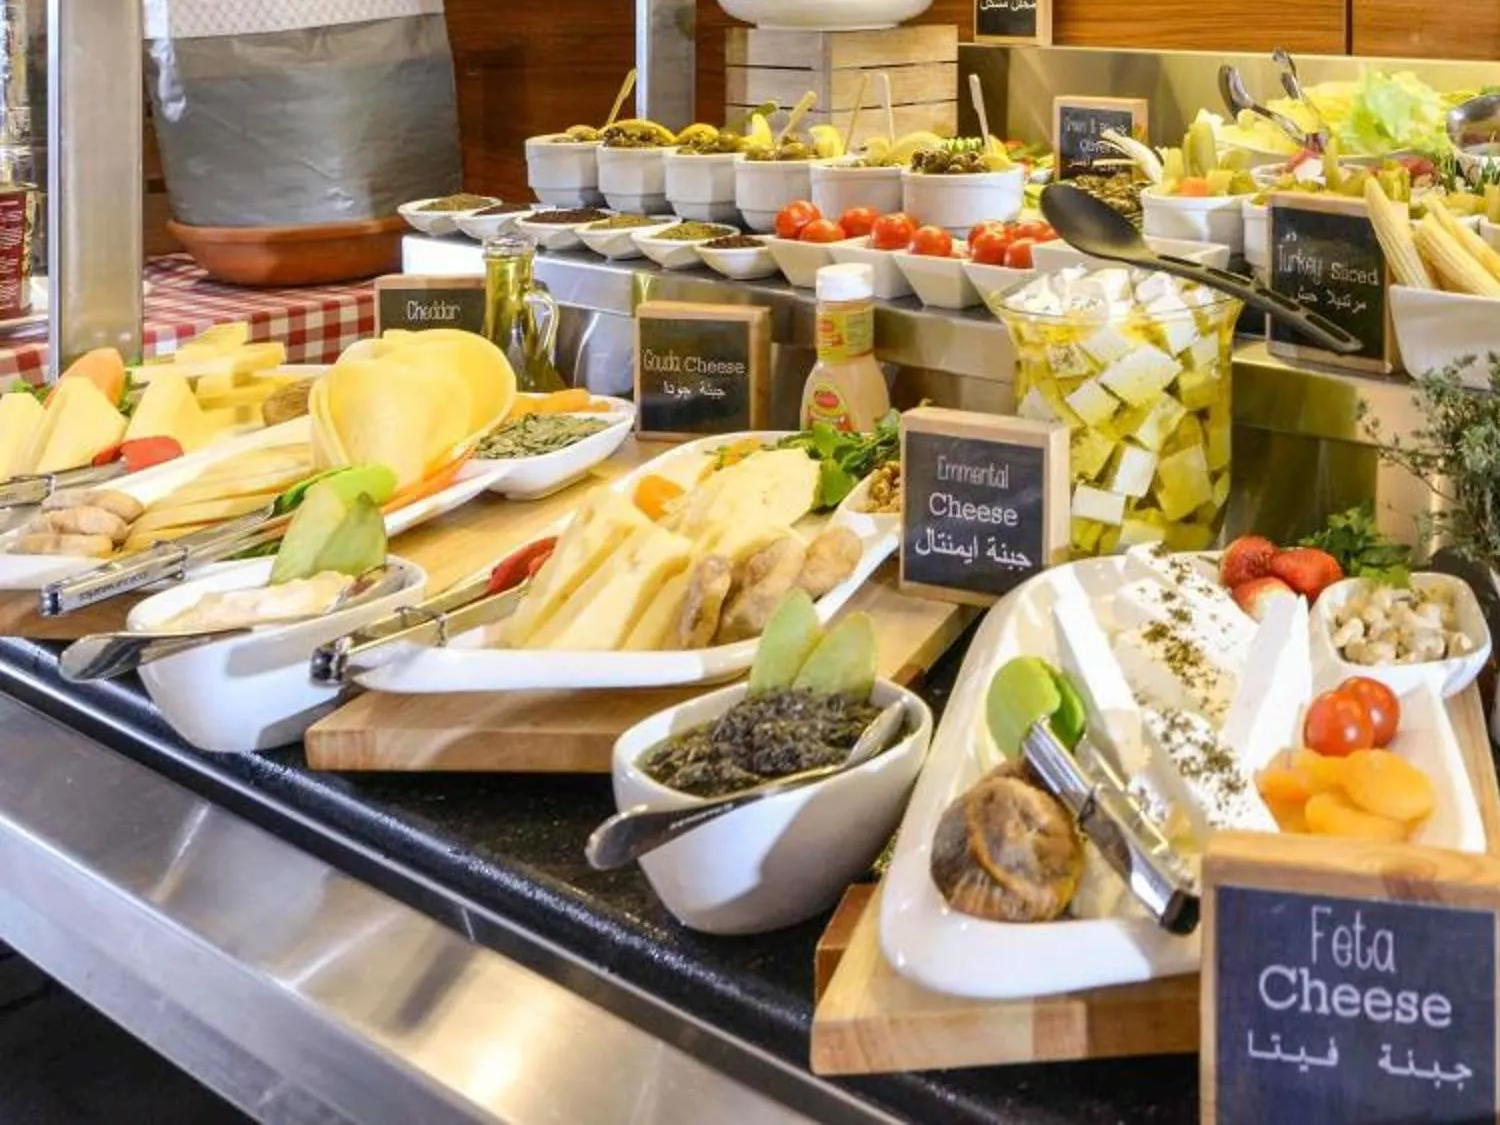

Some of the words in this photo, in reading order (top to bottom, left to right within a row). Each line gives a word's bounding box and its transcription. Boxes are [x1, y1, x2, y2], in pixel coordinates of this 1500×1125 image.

[1277, 244, 1324, 286] Turkey
[1330, 259, 1380, 287] Sliced
[406, 300, 461, 322] Cheddar
[642, 347, 680, 373] Gouda
[683, 355, 746, 375] Cheese
[936, 455, 1010, 490] Emmental
[928, 491, 1019, 527] Cheese
[914, 525, 979, 565] ايمنتال
[985, 534, 1034, 572] جبنة
[1311, 904, 1396, 974] Feta
[1258, 963, 1453, 1029] Cheese
[1247, 1028, 1340, 1073] فيتا
[1378, 1042, 1473, 1092] جبنة
